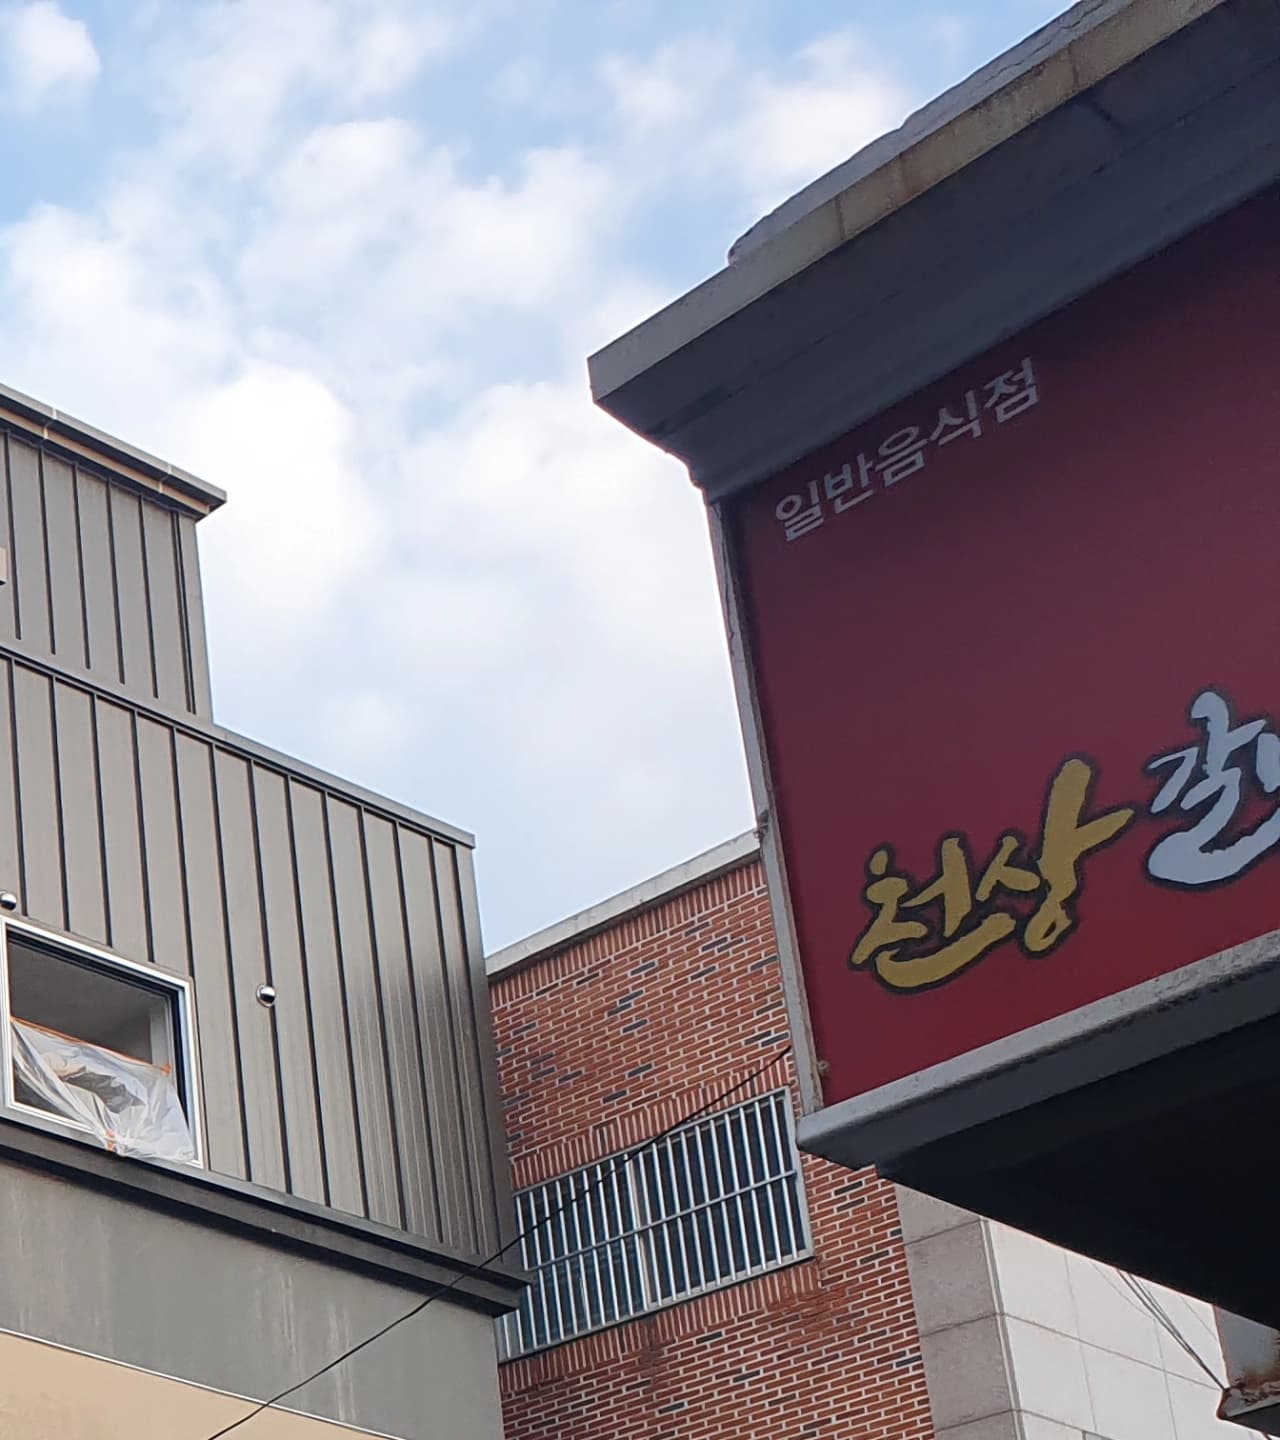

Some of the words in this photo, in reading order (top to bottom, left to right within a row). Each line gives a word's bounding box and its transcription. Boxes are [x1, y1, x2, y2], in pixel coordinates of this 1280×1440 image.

[775, 356, 1040, 542] 일반음식점
[850, 758, 1135, 989] 천상
[1147, 690, 1280, 885] 갈
